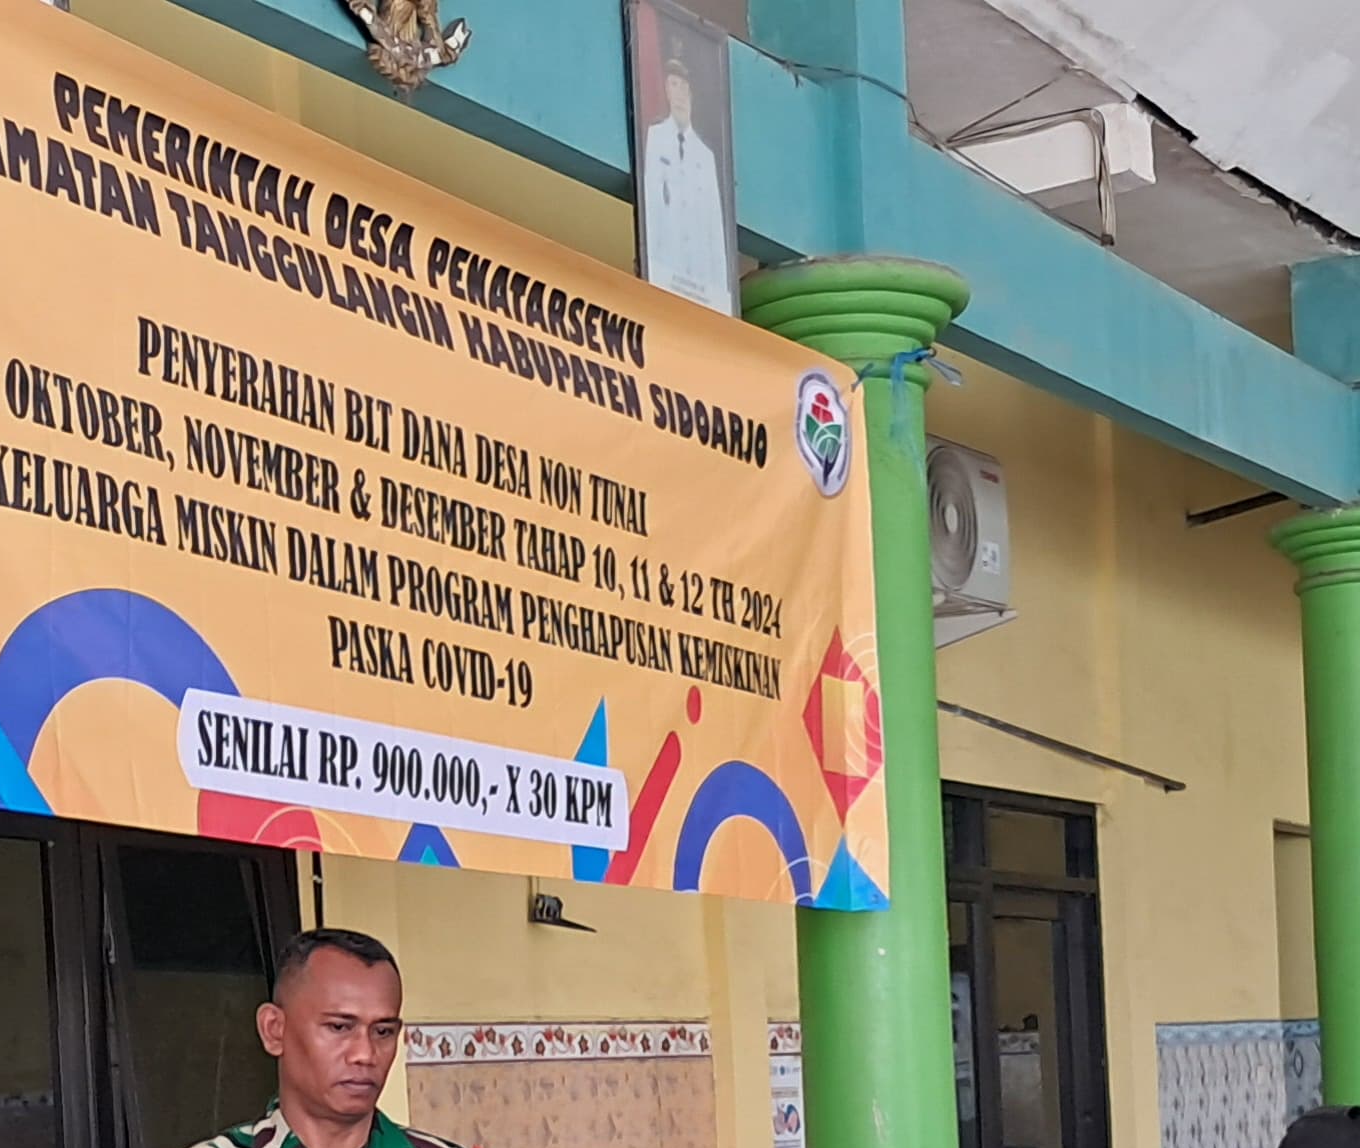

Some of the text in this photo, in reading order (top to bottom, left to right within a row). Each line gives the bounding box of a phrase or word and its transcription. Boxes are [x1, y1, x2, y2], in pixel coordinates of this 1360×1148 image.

[53, 71, 646, 369] PEMERINTAH DESA PENATARSEWU
[168, 191, 455, 352] TANGGULANGIN
[458, 310, 644, 422] KABUPATEN
[649, 381, 768, 468] SIDOARJO
[5, 358, 176, 472] OKTOBER,
[184, 415, 341, 514] NOVEMBER
[350, 468, 372, 521] &
[379, 475, 507, 561] DESEMBER
[513, 518, 587, 584] TAHAP
[592, 542, 626, 602] 10,
[629, 557, 651, 603] 11
[658, 563, 676, 607] &
[680, 569, 704, 617] 12
[709, 576, 737, 626] TH
[741, 585, 783, 640] 2024
[138, 315, 649, 538] PENYERAHAN BLT DANA DESA NON TUNAI
[175, 493, 280, 577] MISKIN
[286, 525, 381, 603] DALAM
[388, 554, 514, 636] PROGRAM
[521, 590, 674, 673] PENGHAPUSAN
[678, 629, 782, 702] KEMISKINAN
[328, 615, 534, 709] PASKA COVID-19
[197, 708, 614, 829] SENILAI RP. 900.000,- X 30 KPM
